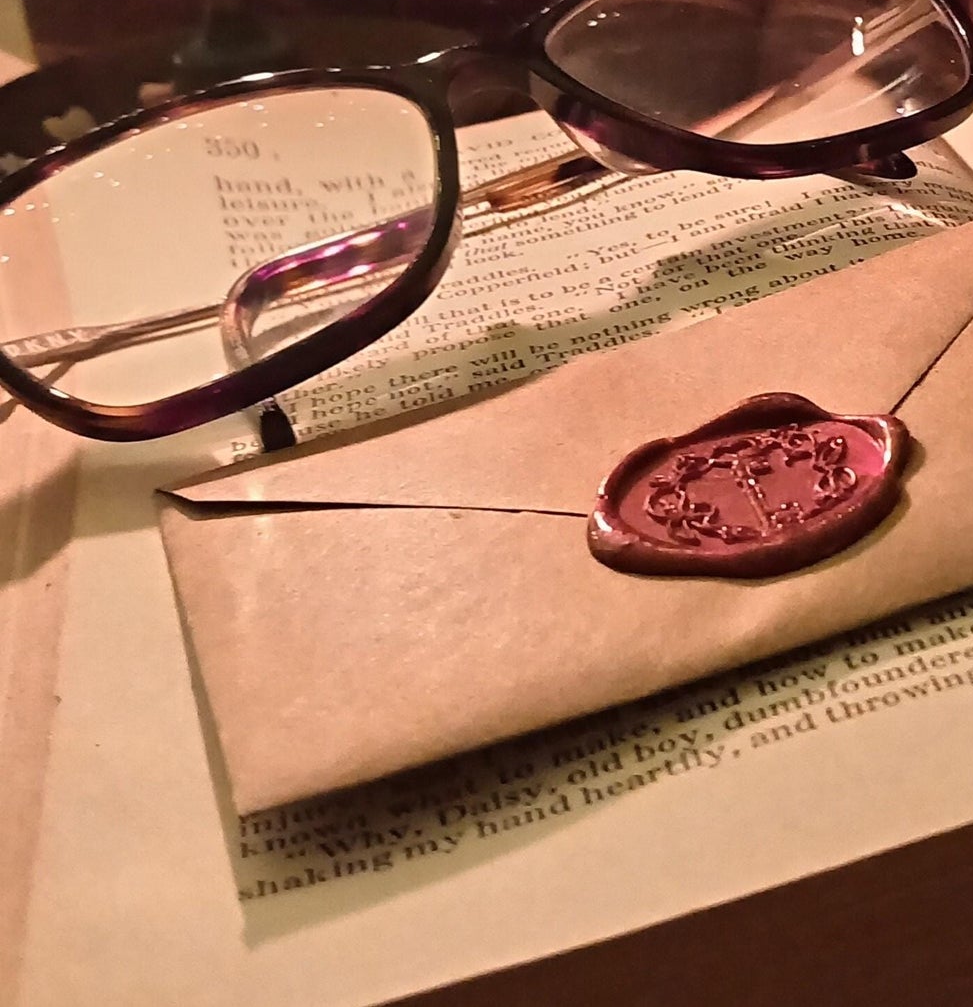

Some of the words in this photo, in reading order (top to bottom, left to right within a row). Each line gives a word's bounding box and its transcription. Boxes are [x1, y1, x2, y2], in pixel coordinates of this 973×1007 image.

[515, 211, 637, 246] something
[736, 203, 803, 224] afraid
[412, 331, 516, 361] propose
[534, 313, 591, 331] that
[679, 279, 710, 292] on
[728, 262, 767, 277] the
[784, 245, 832, 260] way
[422, 307, 544, 334] Traddles.
[696, 246, 748, 265] that
[439, 304, 493, 320] that
[562, 282, 590, 294] be
[620, 248, 702, 278] certain
[466, 319, 521, 335] that
[636, 272, 697, 294] have
[704, 253, 761, 274] been
[772, 227, 875, 253] thinking
[311, 384, 376, 407] hope
[389, 364, 458, 387] there
[469, 349, 517, 367] will
[528, 342, 559, 354] be
[570, 312, 672, 344] nothing
[680, 286, 759, 313] wrong
[768, 264, 838, 288] about
[312, 397, 377, 420] hope
[472, 359, 526, 379] said
[535, 331, 660, 363] Traddles.
[755, 664, 830, 696] how
[844, 651, 880, 670] to
[567, 752, 623, 785] old
[633, 728, 714, 764] boy,
[239, 850, 394, 900] shaking
[475, 794, 571, 839] hand
[579, 744, 741, 806] heartily,
[750, 712, 817, 749] and
